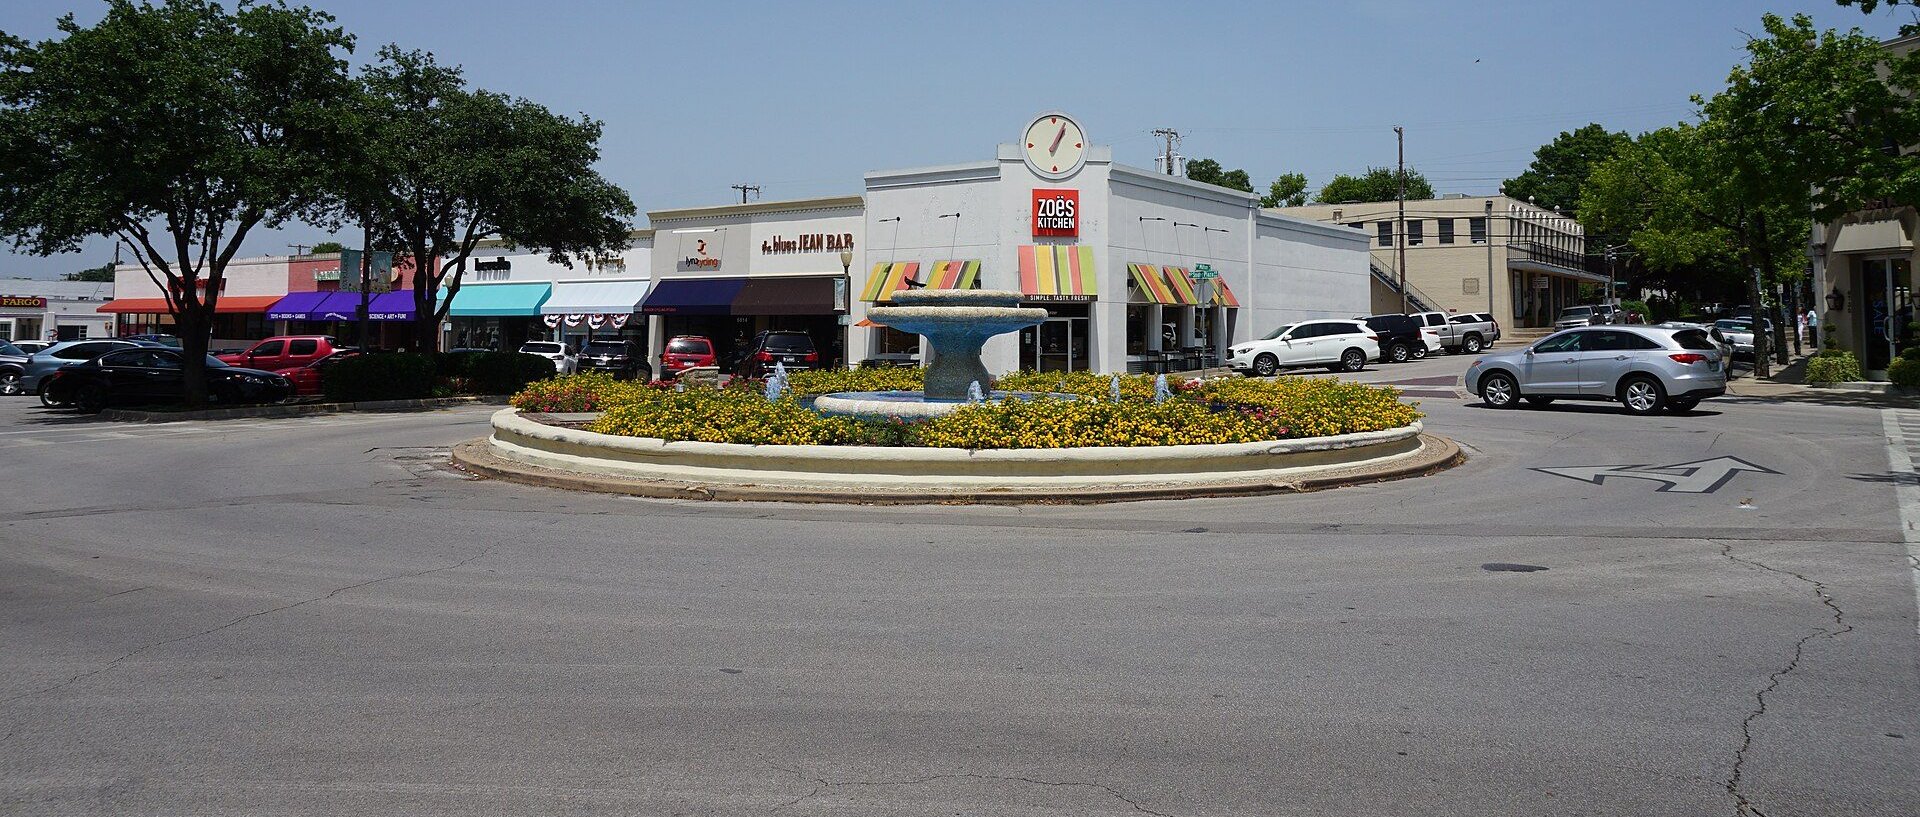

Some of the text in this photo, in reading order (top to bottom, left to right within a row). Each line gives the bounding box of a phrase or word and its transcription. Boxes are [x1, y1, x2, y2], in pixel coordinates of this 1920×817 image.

[1038, 218, 1075, 228] KITCHEN
[773, 235, 796, 251] blues
[798, 234, 823, 250] JEAN
[826, 233, 854, 249] BAR
